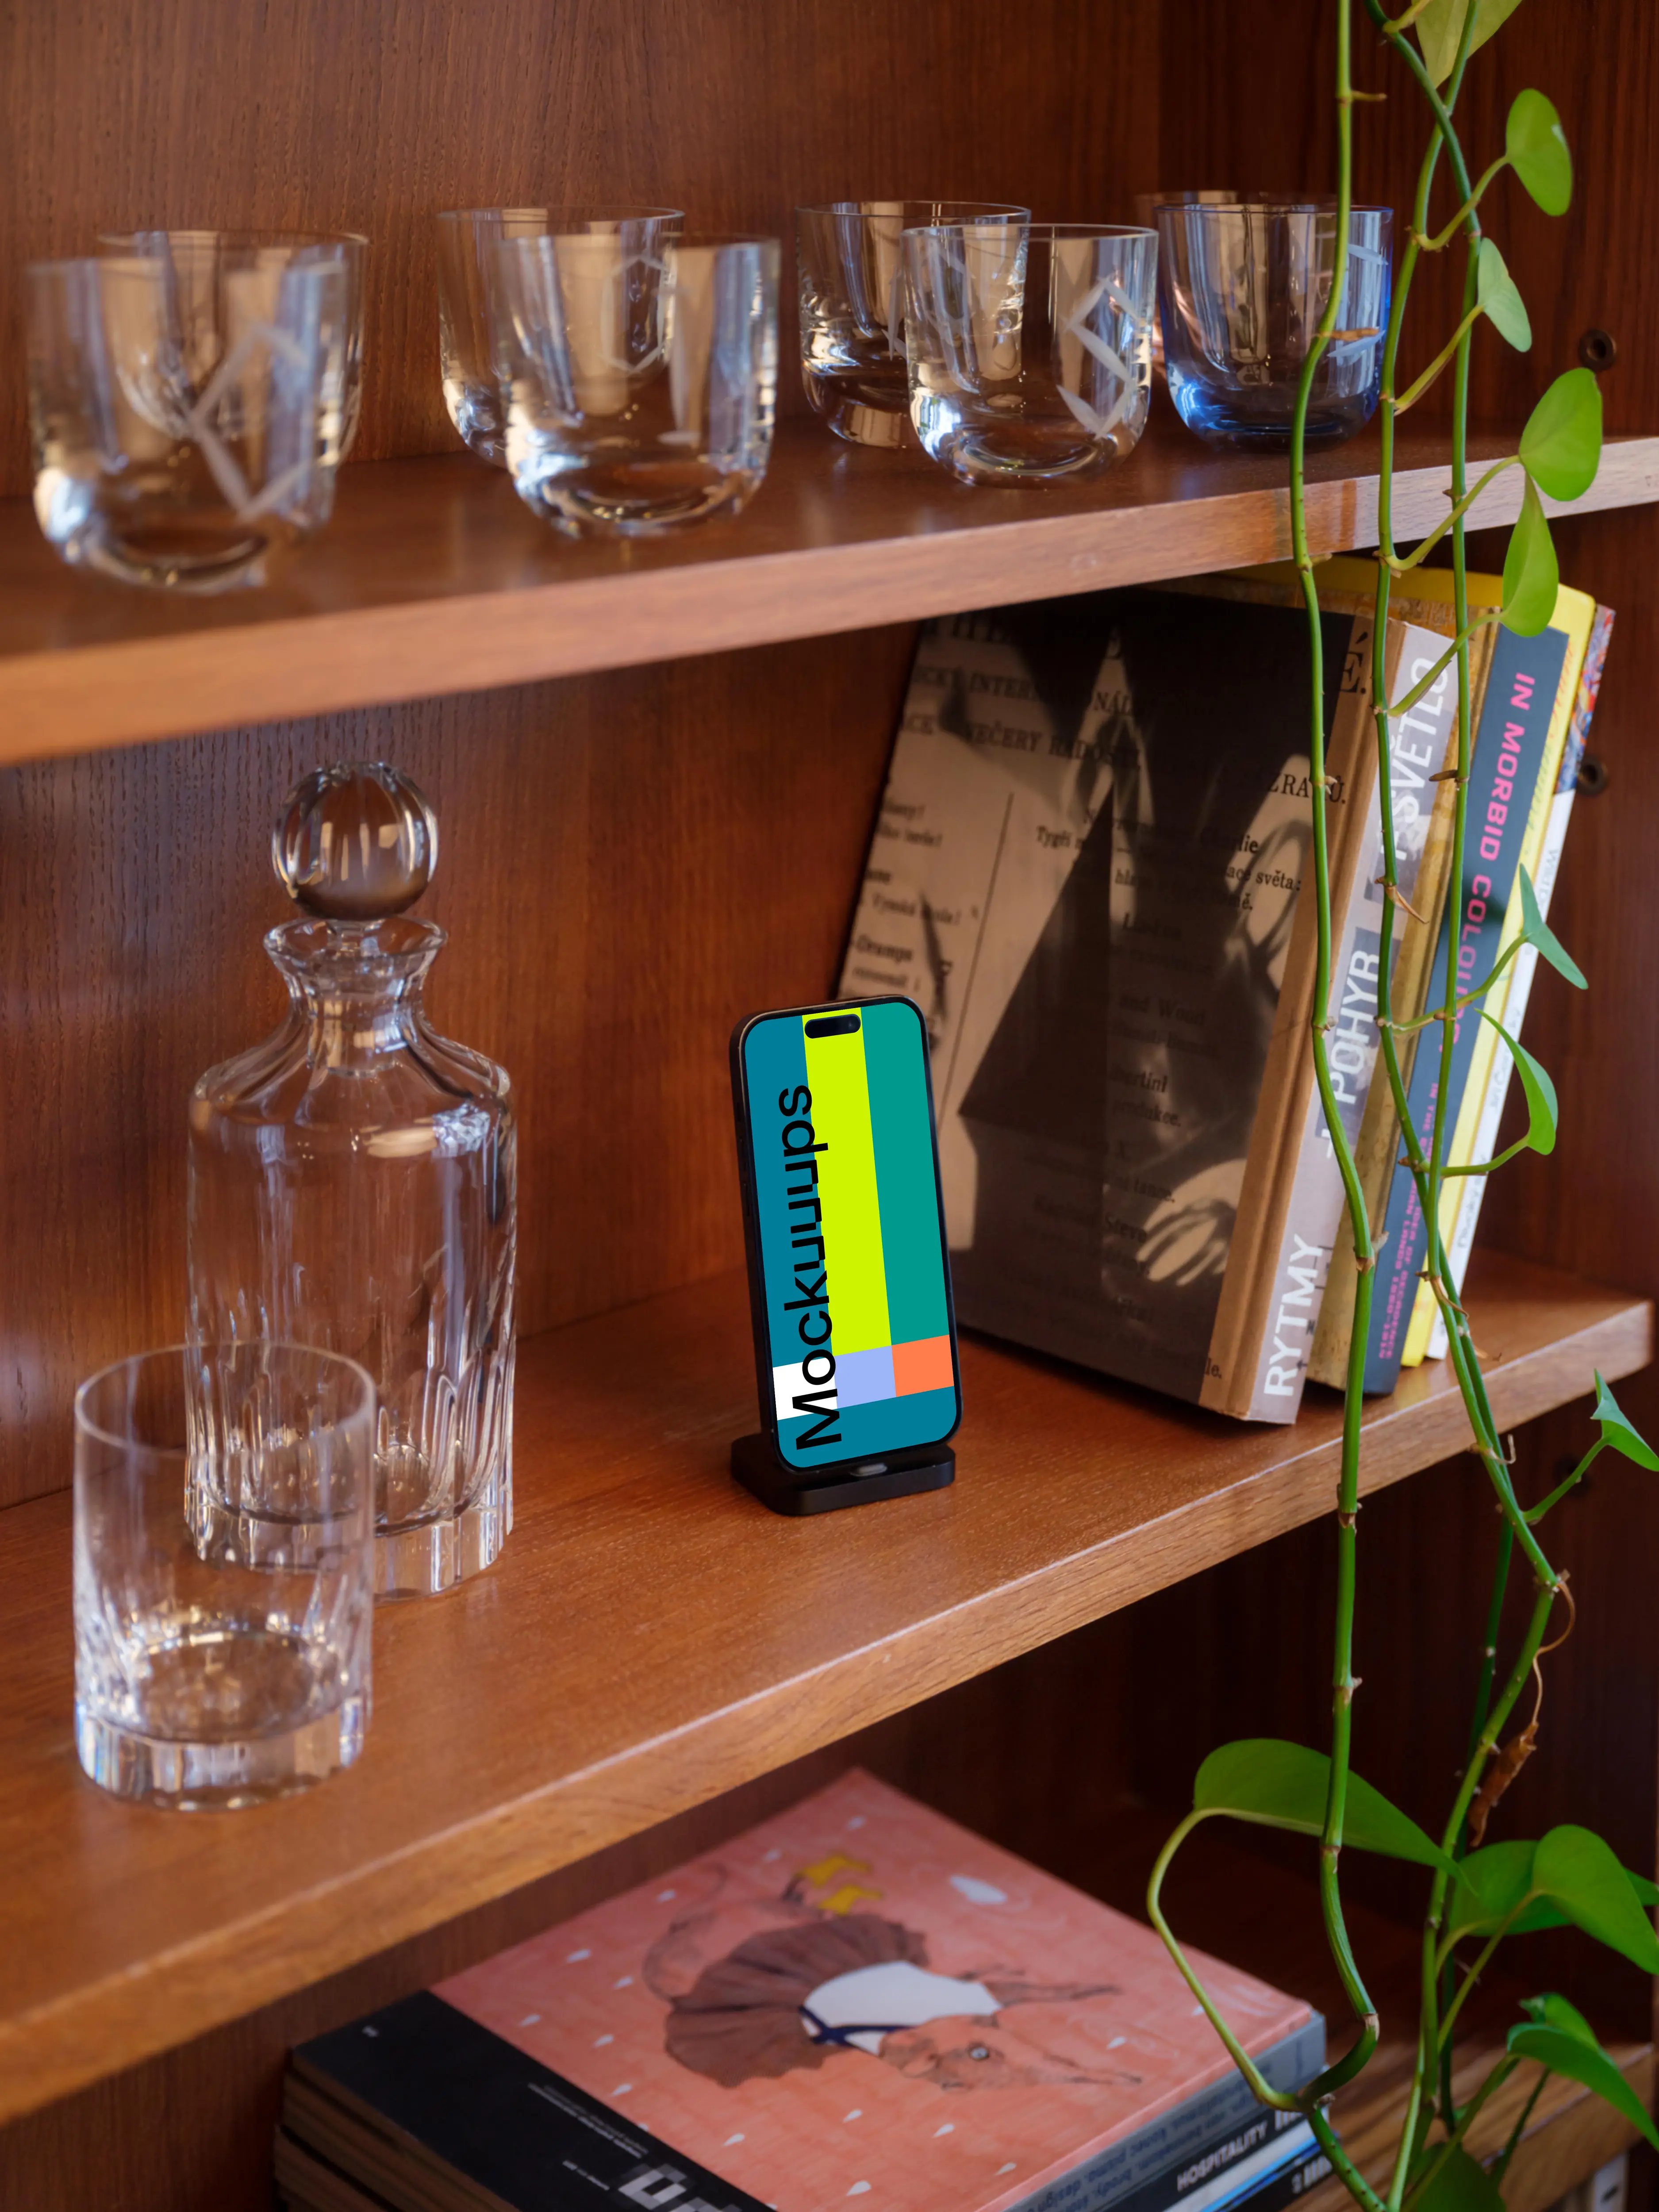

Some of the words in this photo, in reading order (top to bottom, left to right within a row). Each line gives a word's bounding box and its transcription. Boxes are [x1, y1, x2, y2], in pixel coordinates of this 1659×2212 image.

[1510, 672, 1535, 710] IN
[1479, 722, 1525, 861] MORBID
[1256, 870, 1302, 891] světa:
[778, 1084, 842, 1450] Mockuuups
[1263, 1234, 1324, 1396] RYTMY
[1177, 2120, 1268, 2192] HOSPITALITY
